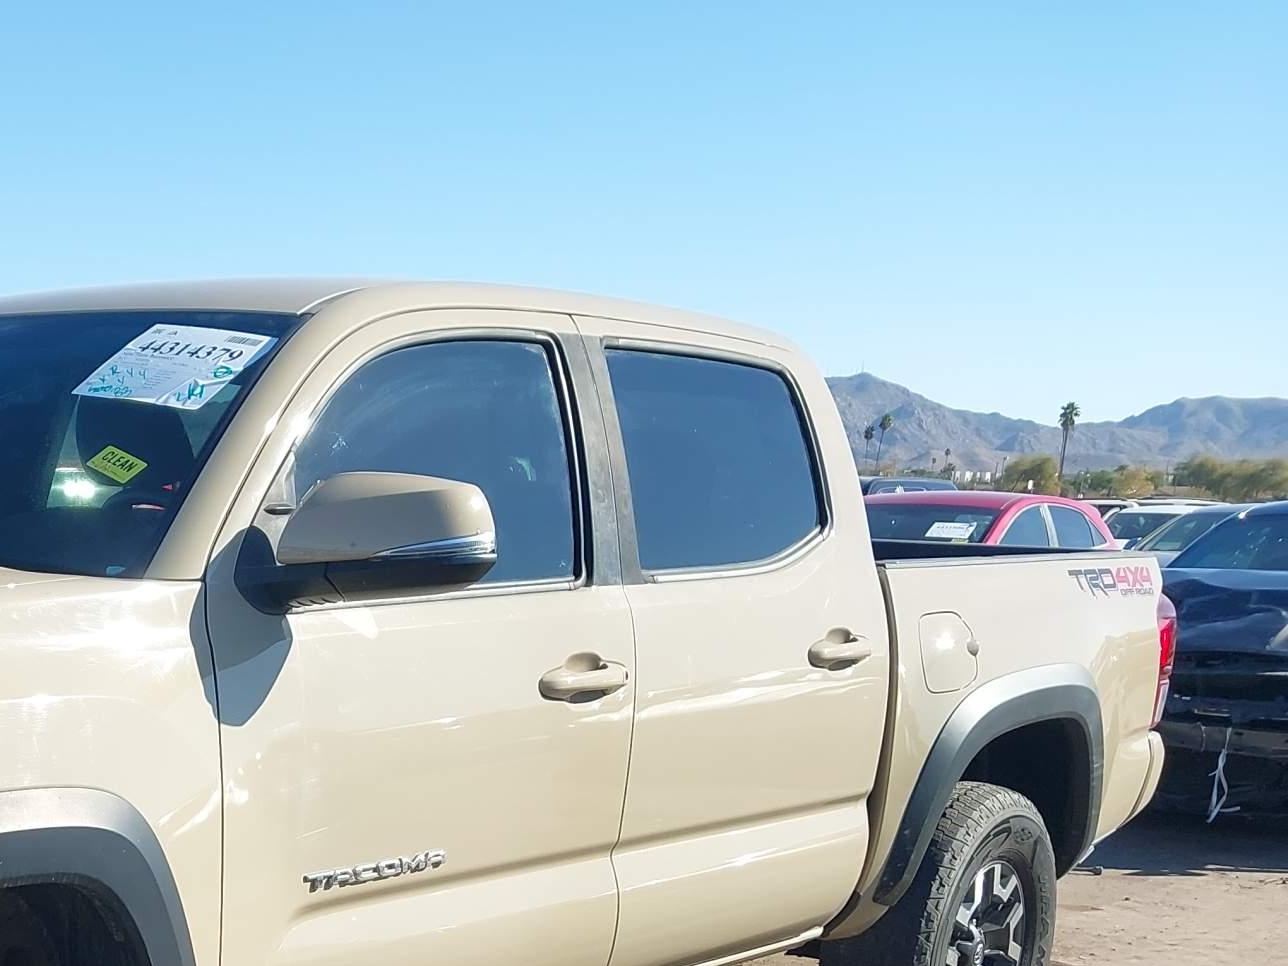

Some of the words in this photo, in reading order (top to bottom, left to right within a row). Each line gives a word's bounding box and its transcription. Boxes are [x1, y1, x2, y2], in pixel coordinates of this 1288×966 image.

[139, 339, 244, 363] 44314379
[102, 450, 138, 473] CLEAN
[1067, 567, 1118, 598] TRD
[302, 849, 447, 894] TACOMA
